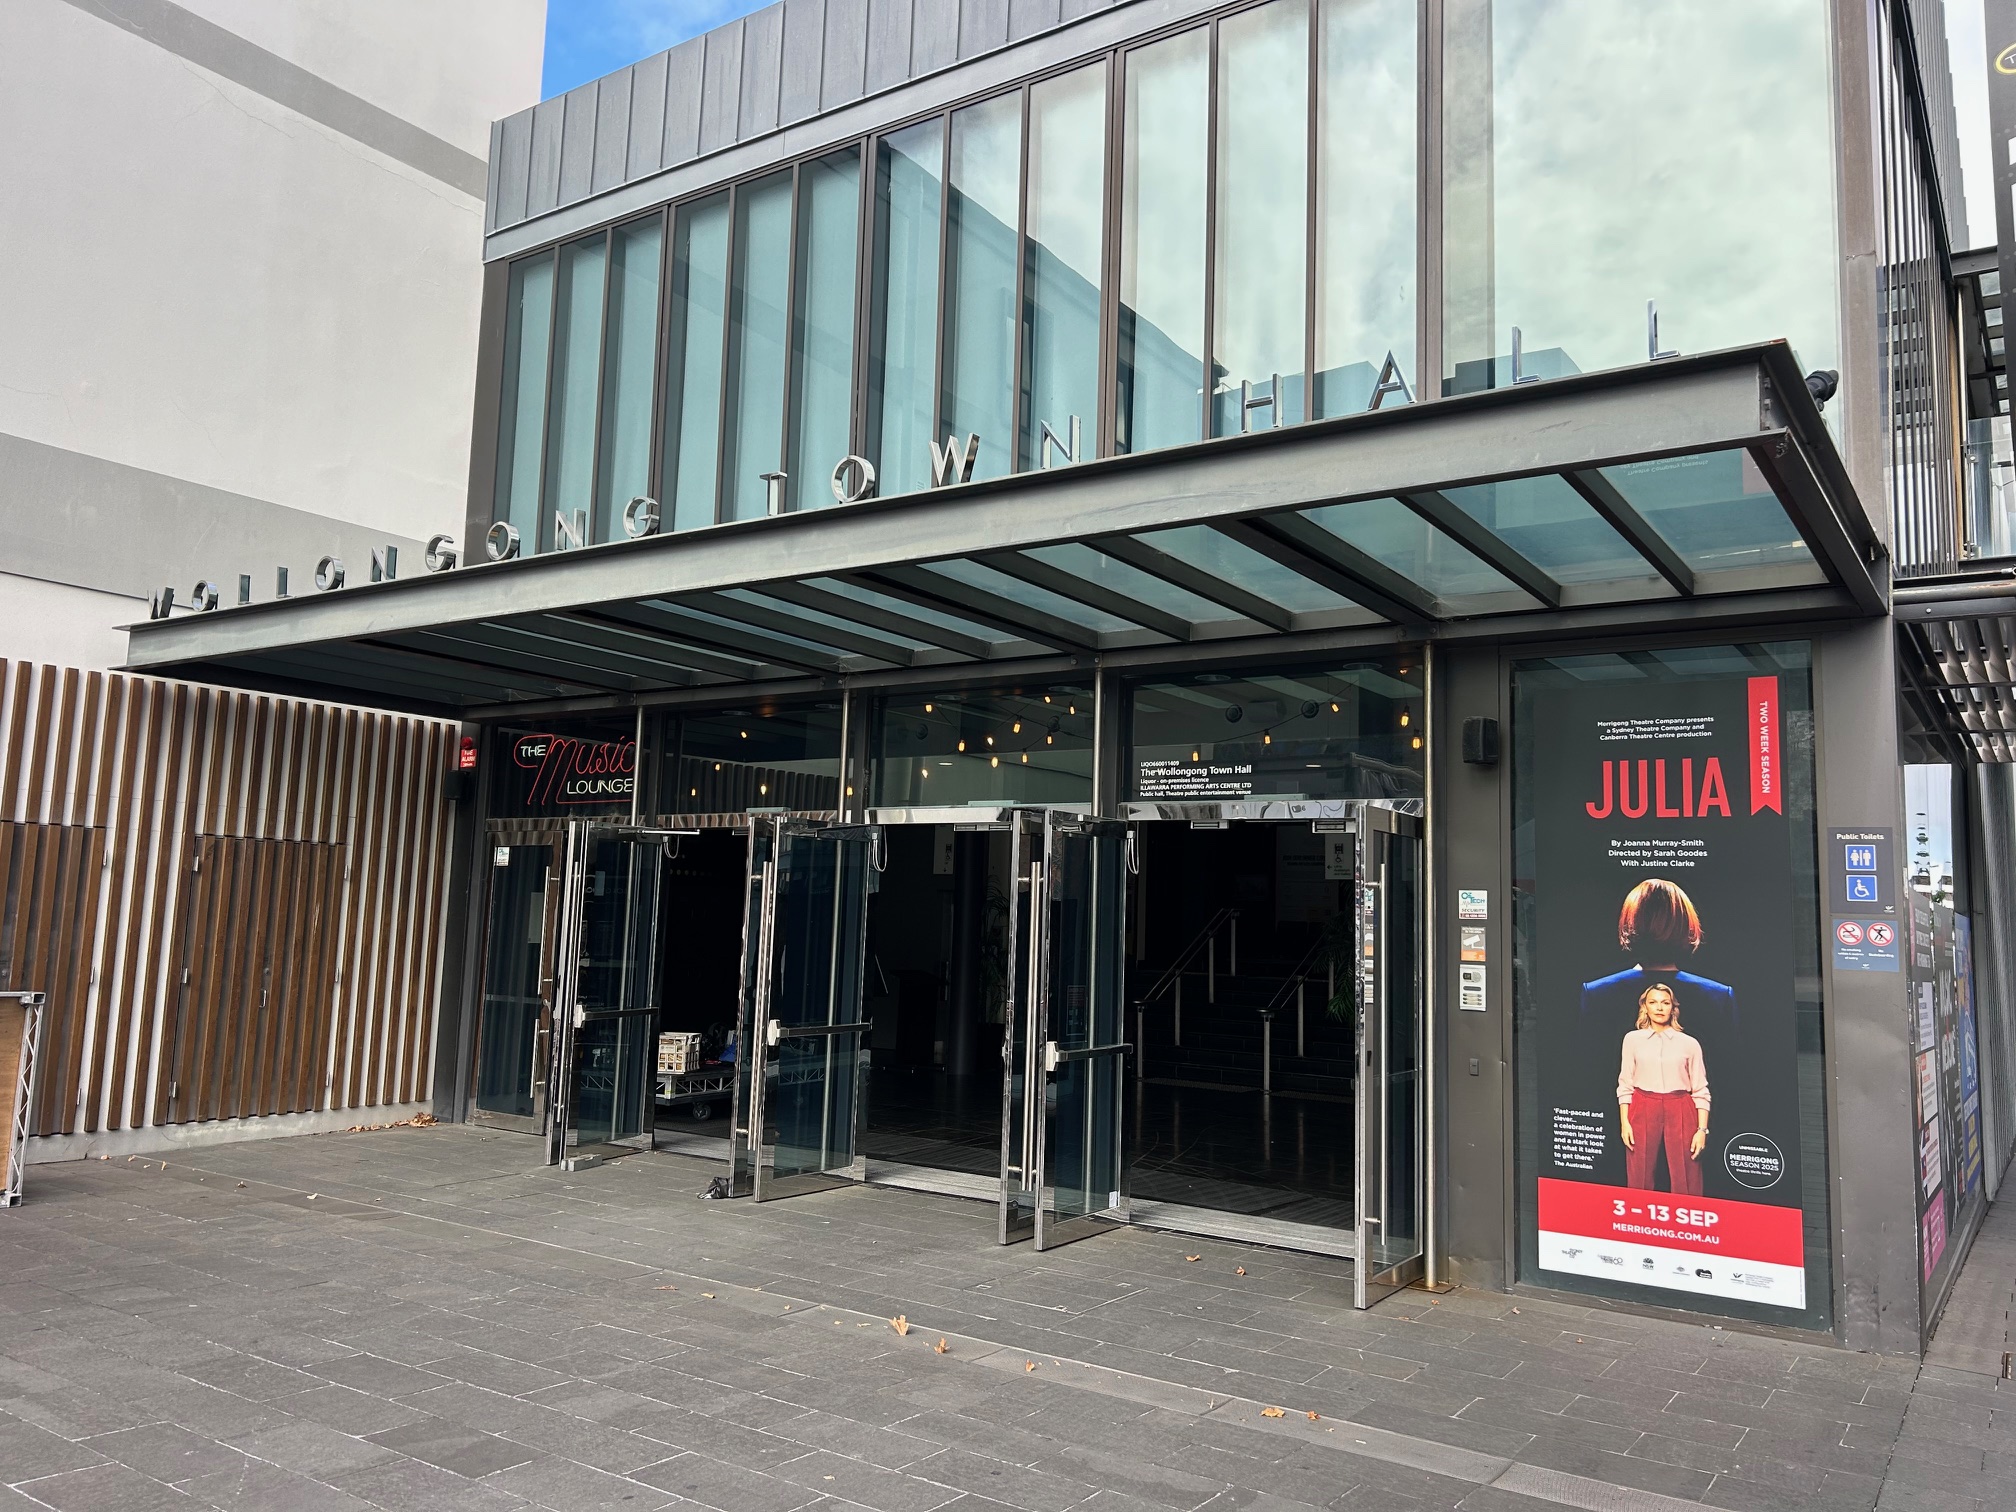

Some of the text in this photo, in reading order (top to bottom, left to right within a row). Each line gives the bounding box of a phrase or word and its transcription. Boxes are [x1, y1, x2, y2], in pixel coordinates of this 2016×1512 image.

[147, 299, 1681, 619] WOLLONGONG TOWN HALL
[520, 745, 546, 758] THE
[1760, 701, 1770, 793] TWO WEEK SEASON
[1141, 768, 1155, 776] The
[1157, 768, 1207, 776] Wollongong
[1235, 765, 1251, 774] Hall
[567, 778, 633, 794] LOUNGE
[1585, 757, 1732, 818] JULIA
[1559, 1123, 1594, 1131] celebration
[1730, 1154, 1779, 1164] MERRIGONG
[1730, 1160, 1760, 1169] SEASON
[1613, 1200, 1625, 1216] 3
[1647, 1204, 1670, 1221] 13
[1675, 1208, 1718, 1227] SEP
[1613, 1222, 1719, 1244] MERRIGONG.COM.AU
